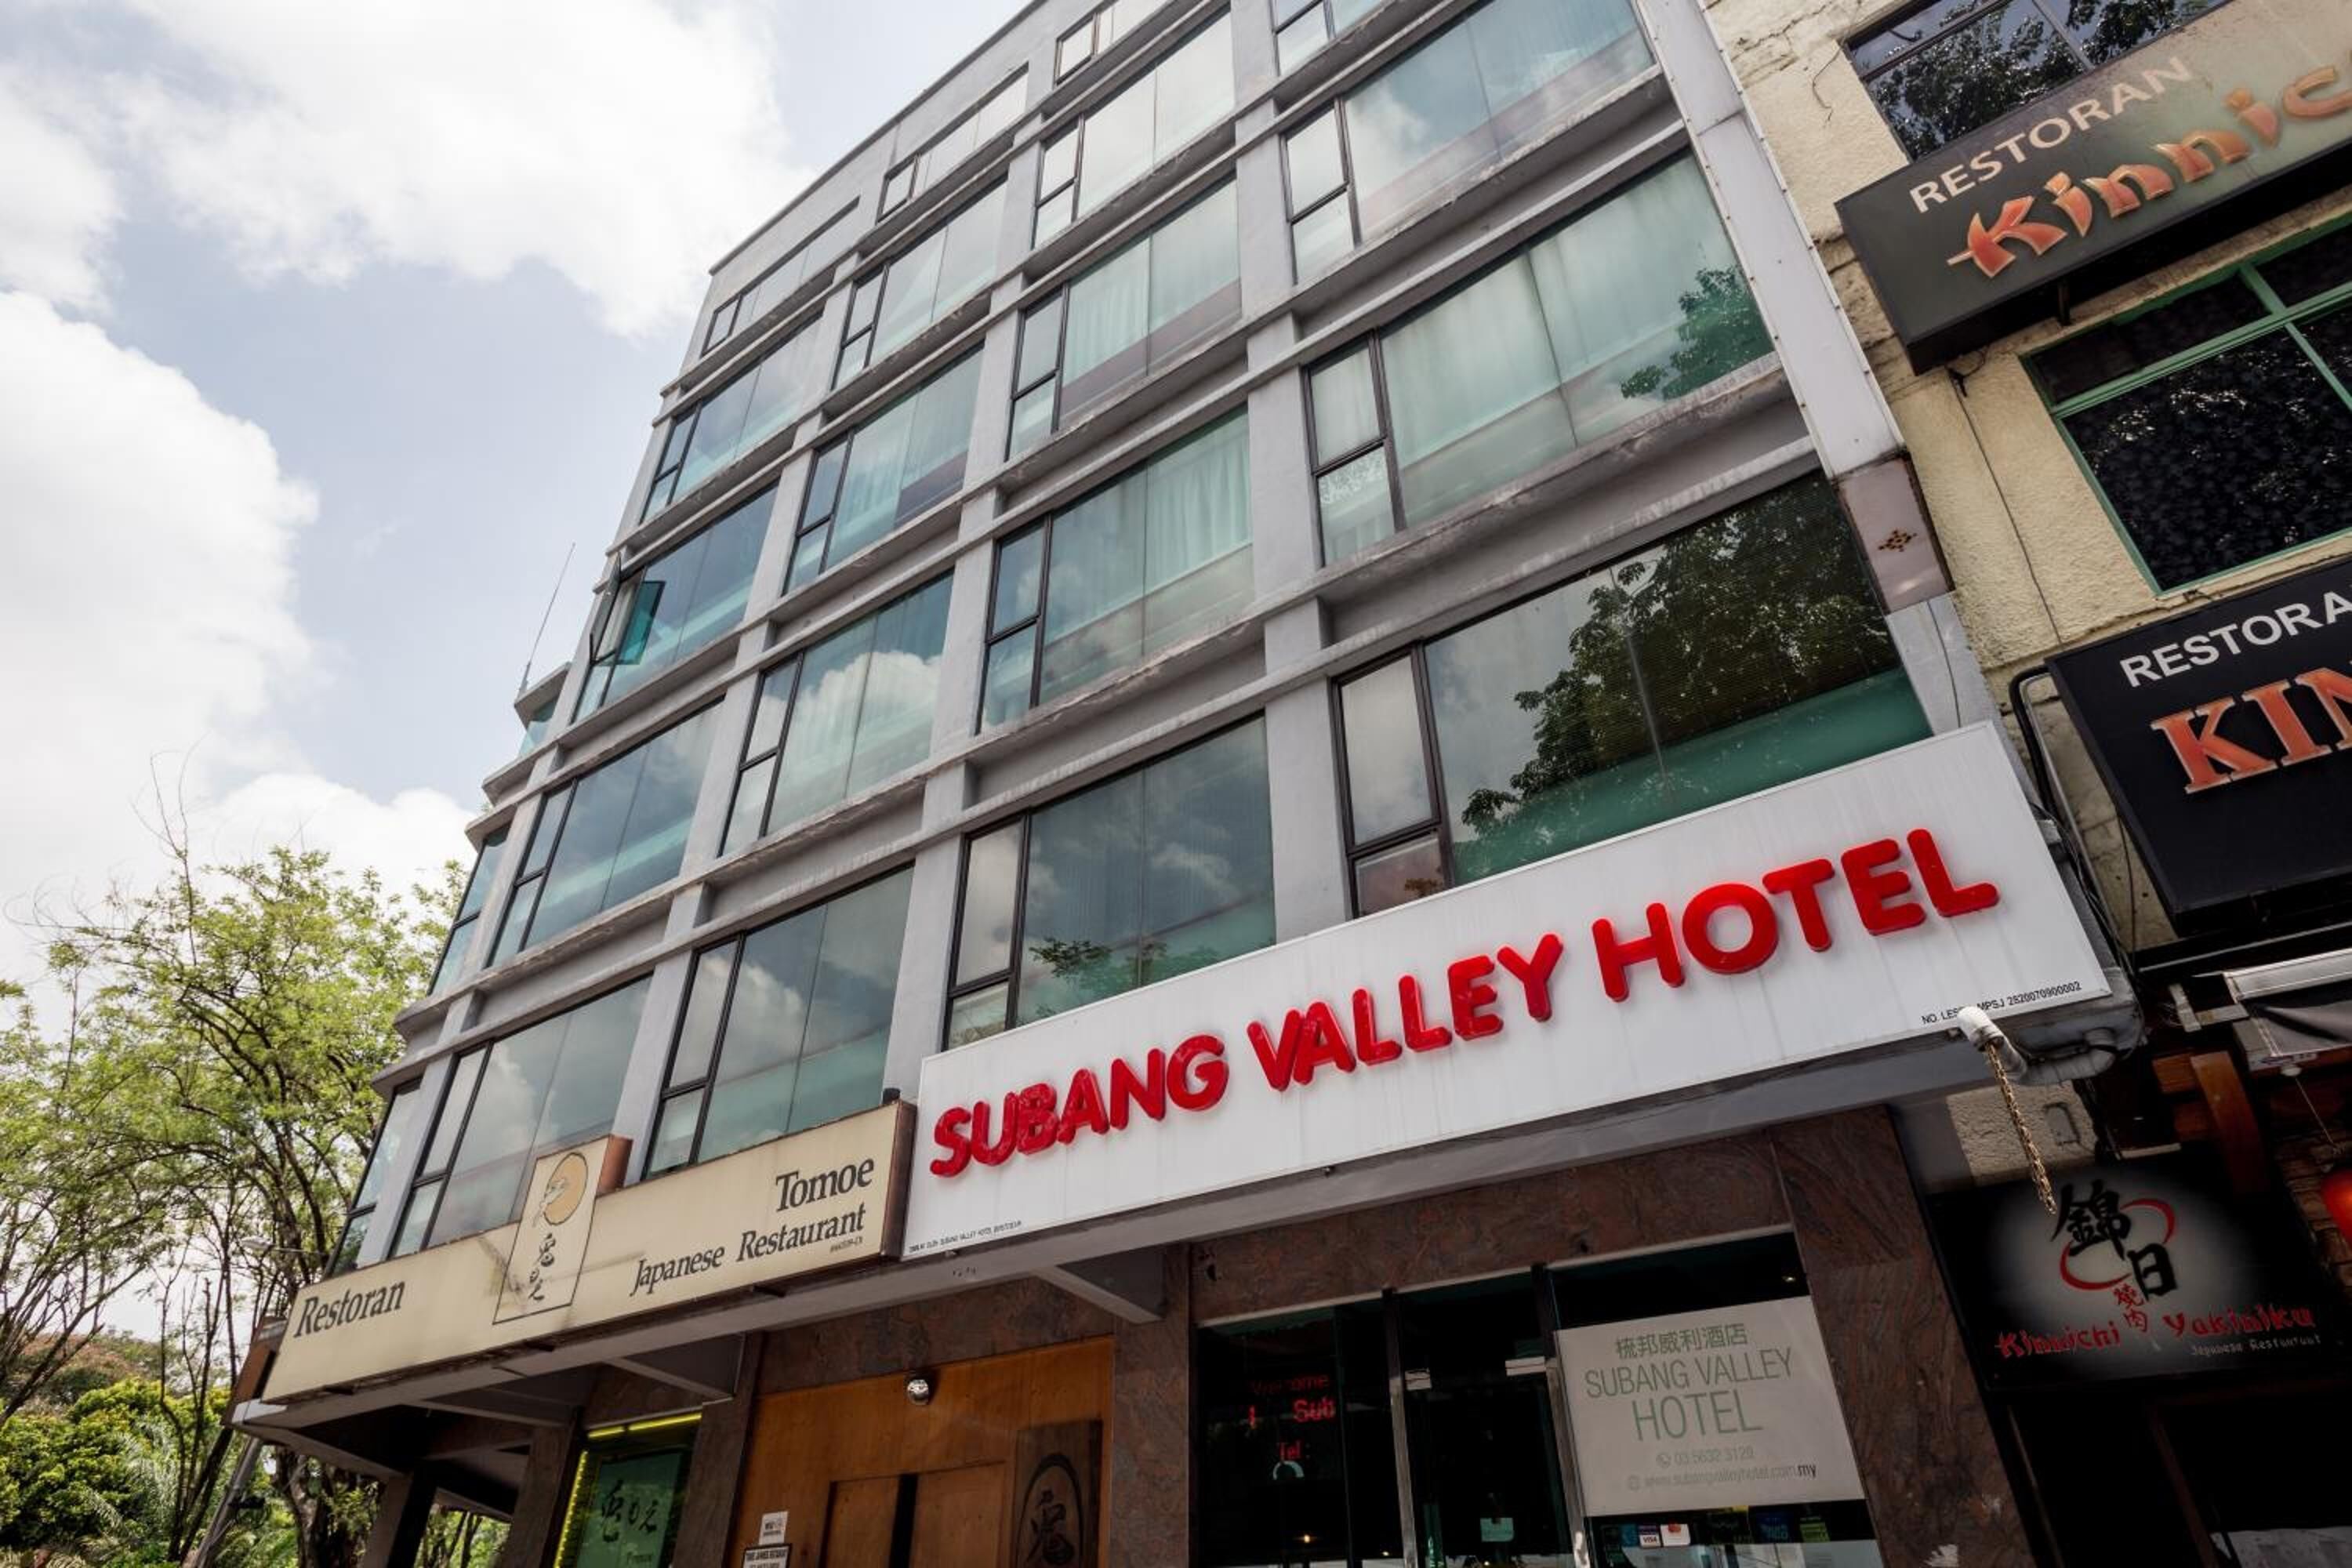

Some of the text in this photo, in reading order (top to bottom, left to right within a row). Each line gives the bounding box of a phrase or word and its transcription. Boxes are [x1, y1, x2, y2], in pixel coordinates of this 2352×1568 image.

[1908, 56, 2194, 214] RESTORAN
[1947, 63, 2352, 279] Kinnic
[2119, 583, 2352, 688] RESTORA
[930, 828, 1999, 1178] SUBANG VALLEY HOTEL
[775, 1157, 874, 1212] Tomoe
[630, 1202, 866, 1297] Japanese Restaurant
[293, 1281, 405, 1338] Restoran
[1584, 1347, 1792, 1399] SUBANG VALLEY
[1632, 1389, 1764, 1441] HOTEL
